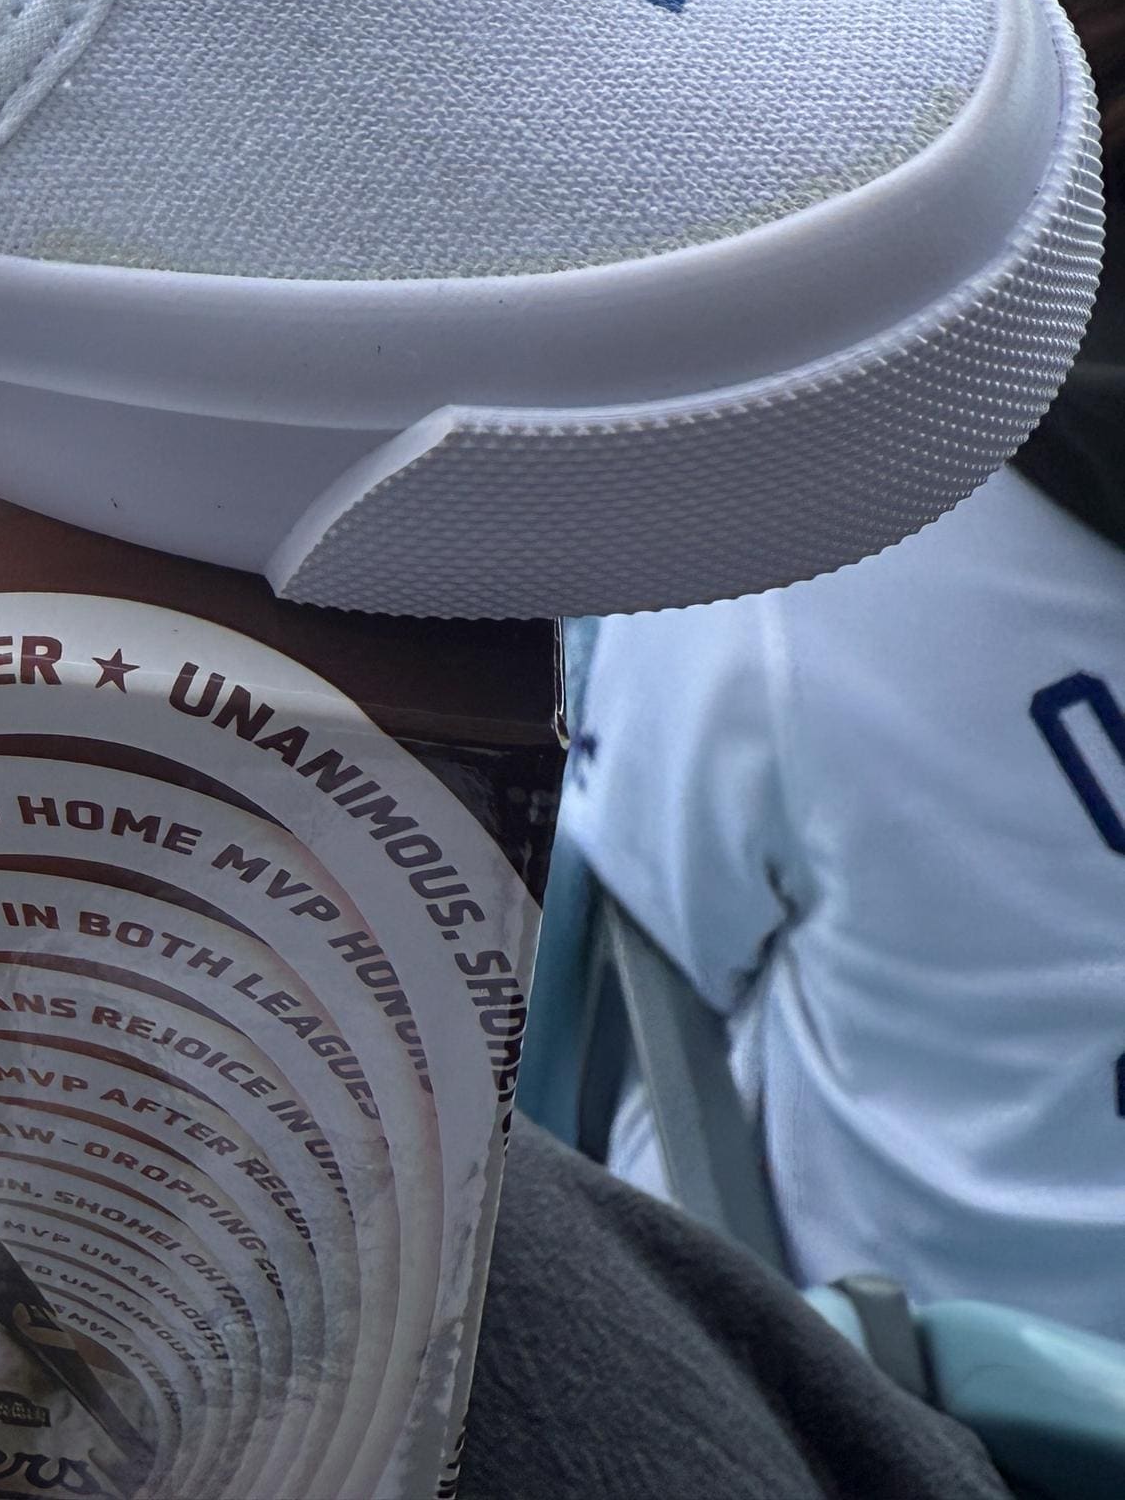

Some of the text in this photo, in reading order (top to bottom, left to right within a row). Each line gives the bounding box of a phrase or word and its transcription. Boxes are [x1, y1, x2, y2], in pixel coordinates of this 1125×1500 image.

[168, 662, 486, 940] UNANIMOUS.
[17, 795, 202, 855] HOME
[212, 844, 341, 921] MVP
[1, 902, 58, 929] IN
[79, 911, 234, 977] BOTH
[91, 1007, 277, 1098] REJOICE
[267, 1100, 323, 1133] IN
[100, 1088, 240, 1157] AFTER
[3, 1220, 71, 1243] MVP
[54, 1190, 182, 1251] SHOHEI
[69, 1313, 117, 1340] MVP
